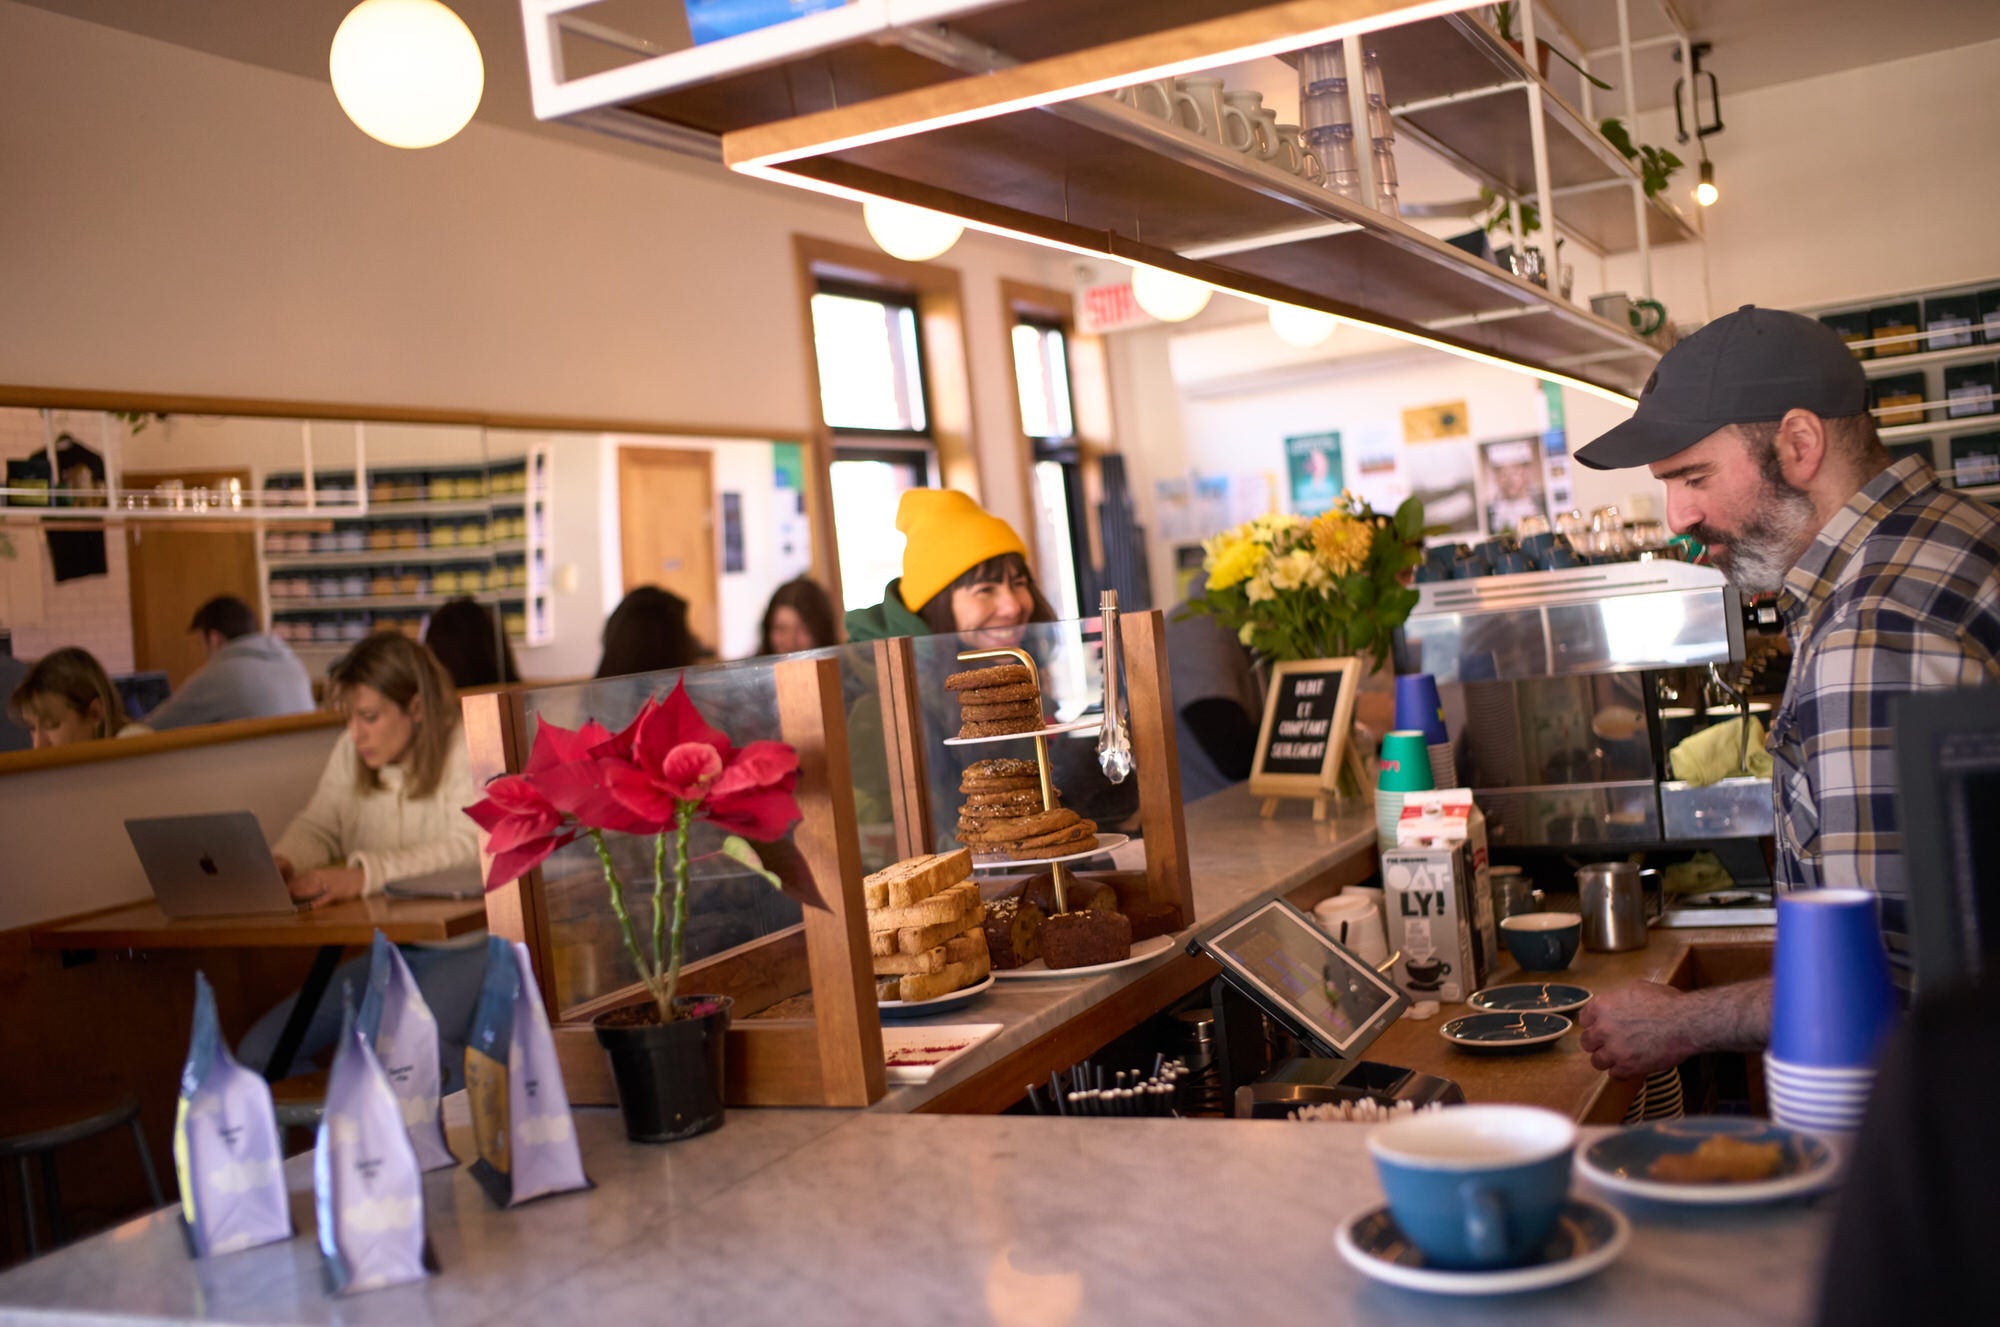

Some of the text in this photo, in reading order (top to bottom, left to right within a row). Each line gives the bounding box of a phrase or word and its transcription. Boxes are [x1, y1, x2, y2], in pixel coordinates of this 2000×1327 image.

[1296, 702, 1313, 718] ET
[1278, 719, 1329, 737] COMPTANT
[1271, 742, 1325, 759] SEULEMENT
[1400, 891, 1446, 917] LY!
